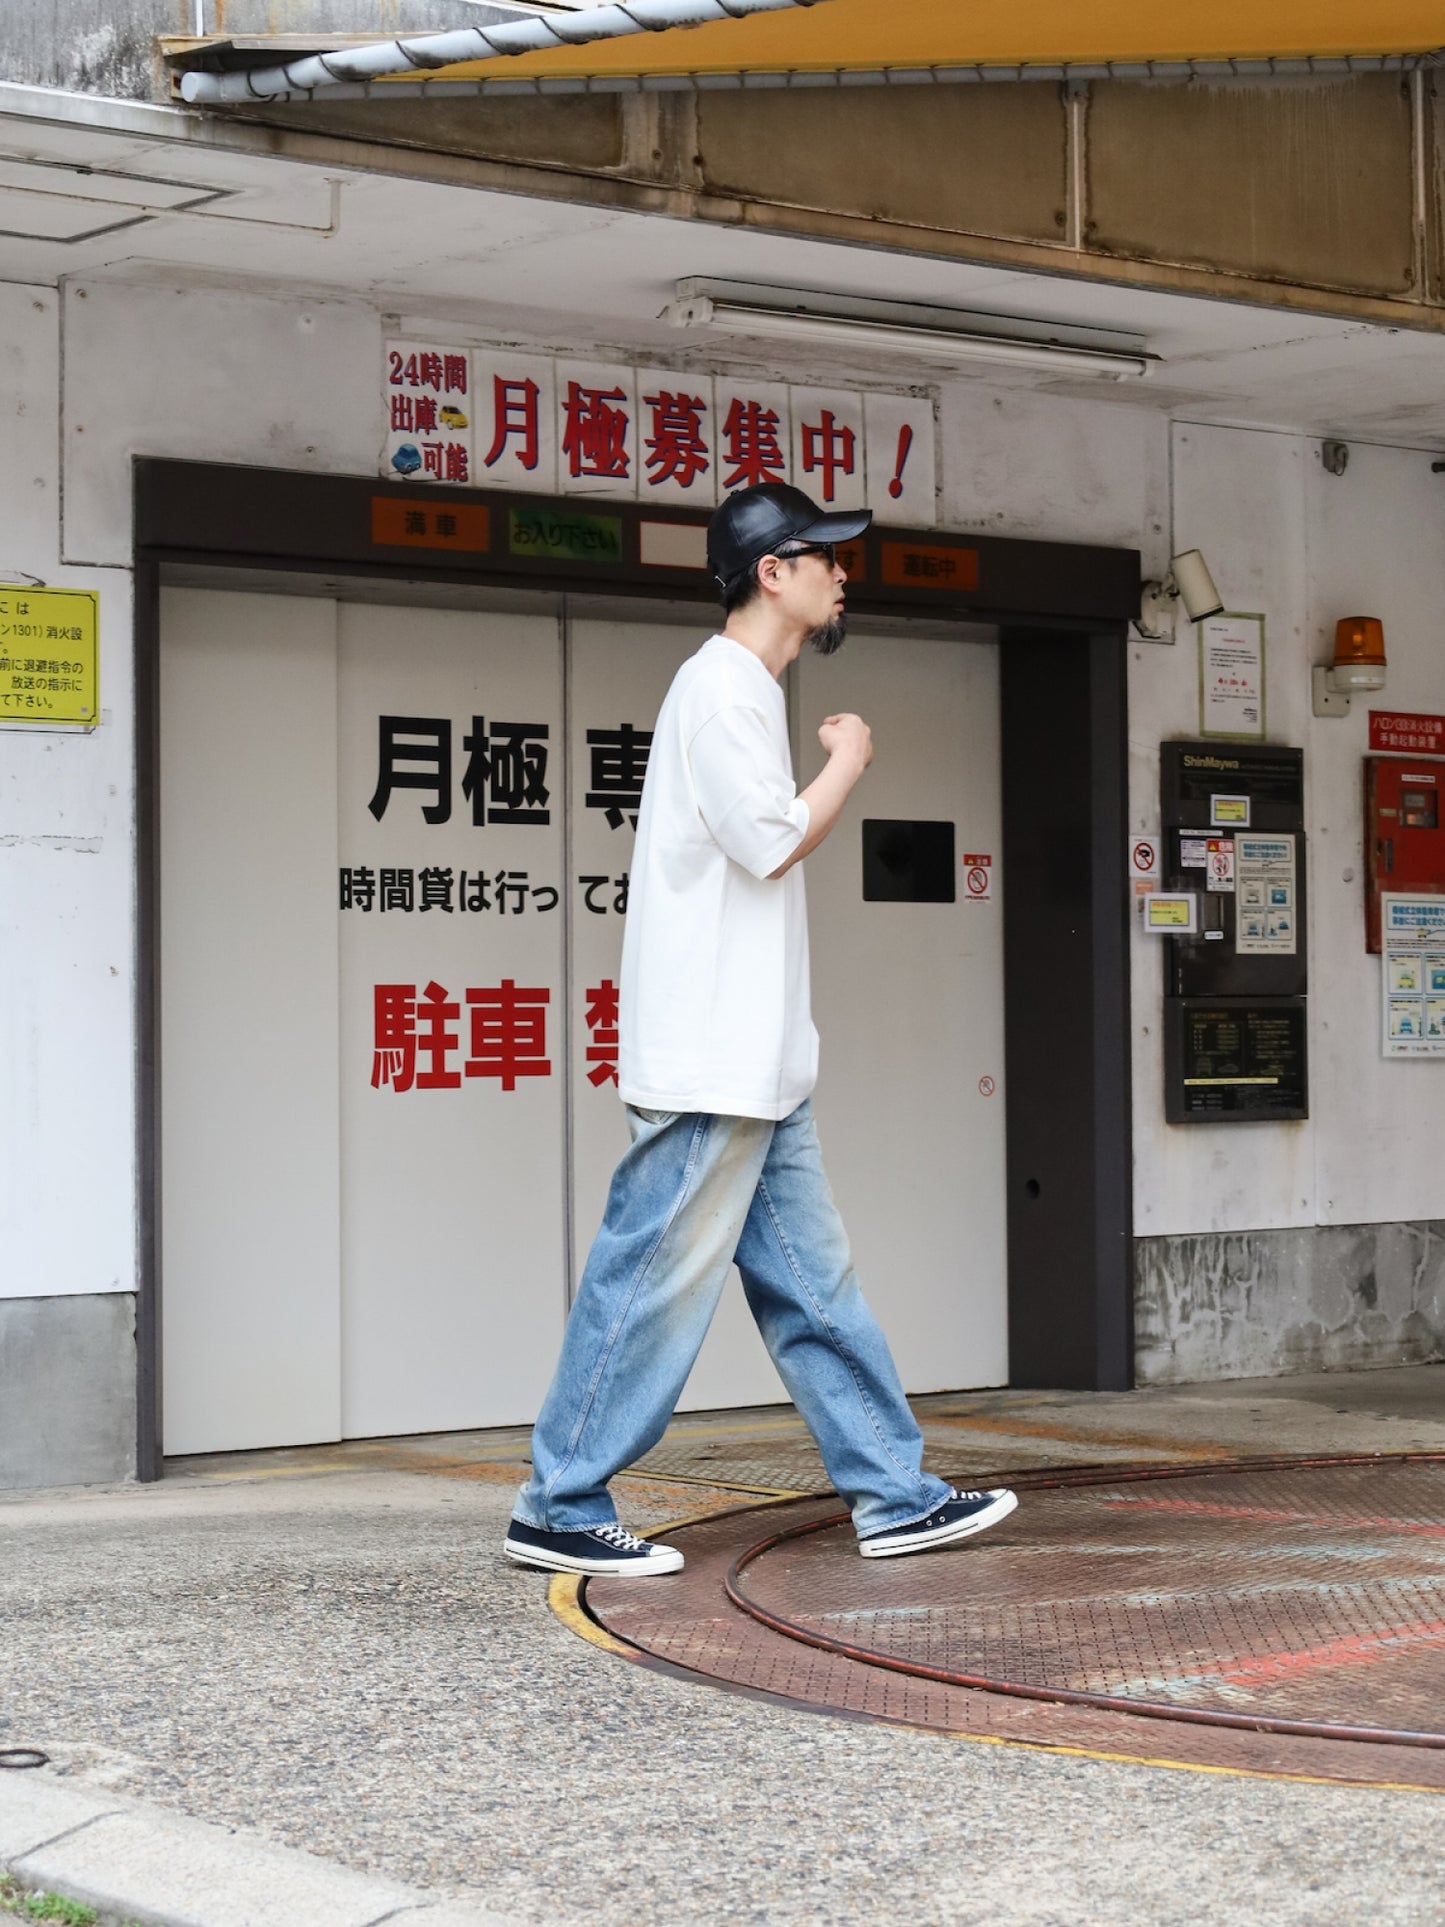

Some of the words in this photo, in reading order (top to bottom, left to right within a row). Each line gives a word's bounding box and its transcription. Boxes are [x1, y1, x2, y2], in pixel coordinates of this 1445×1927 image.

[389, 351, 467, 394] 24時間
[391, 394, 438, 434] 出庫
[421, 442, 468, 482] 可能
[1184, 754, 1240, 771] ShinMaywa
